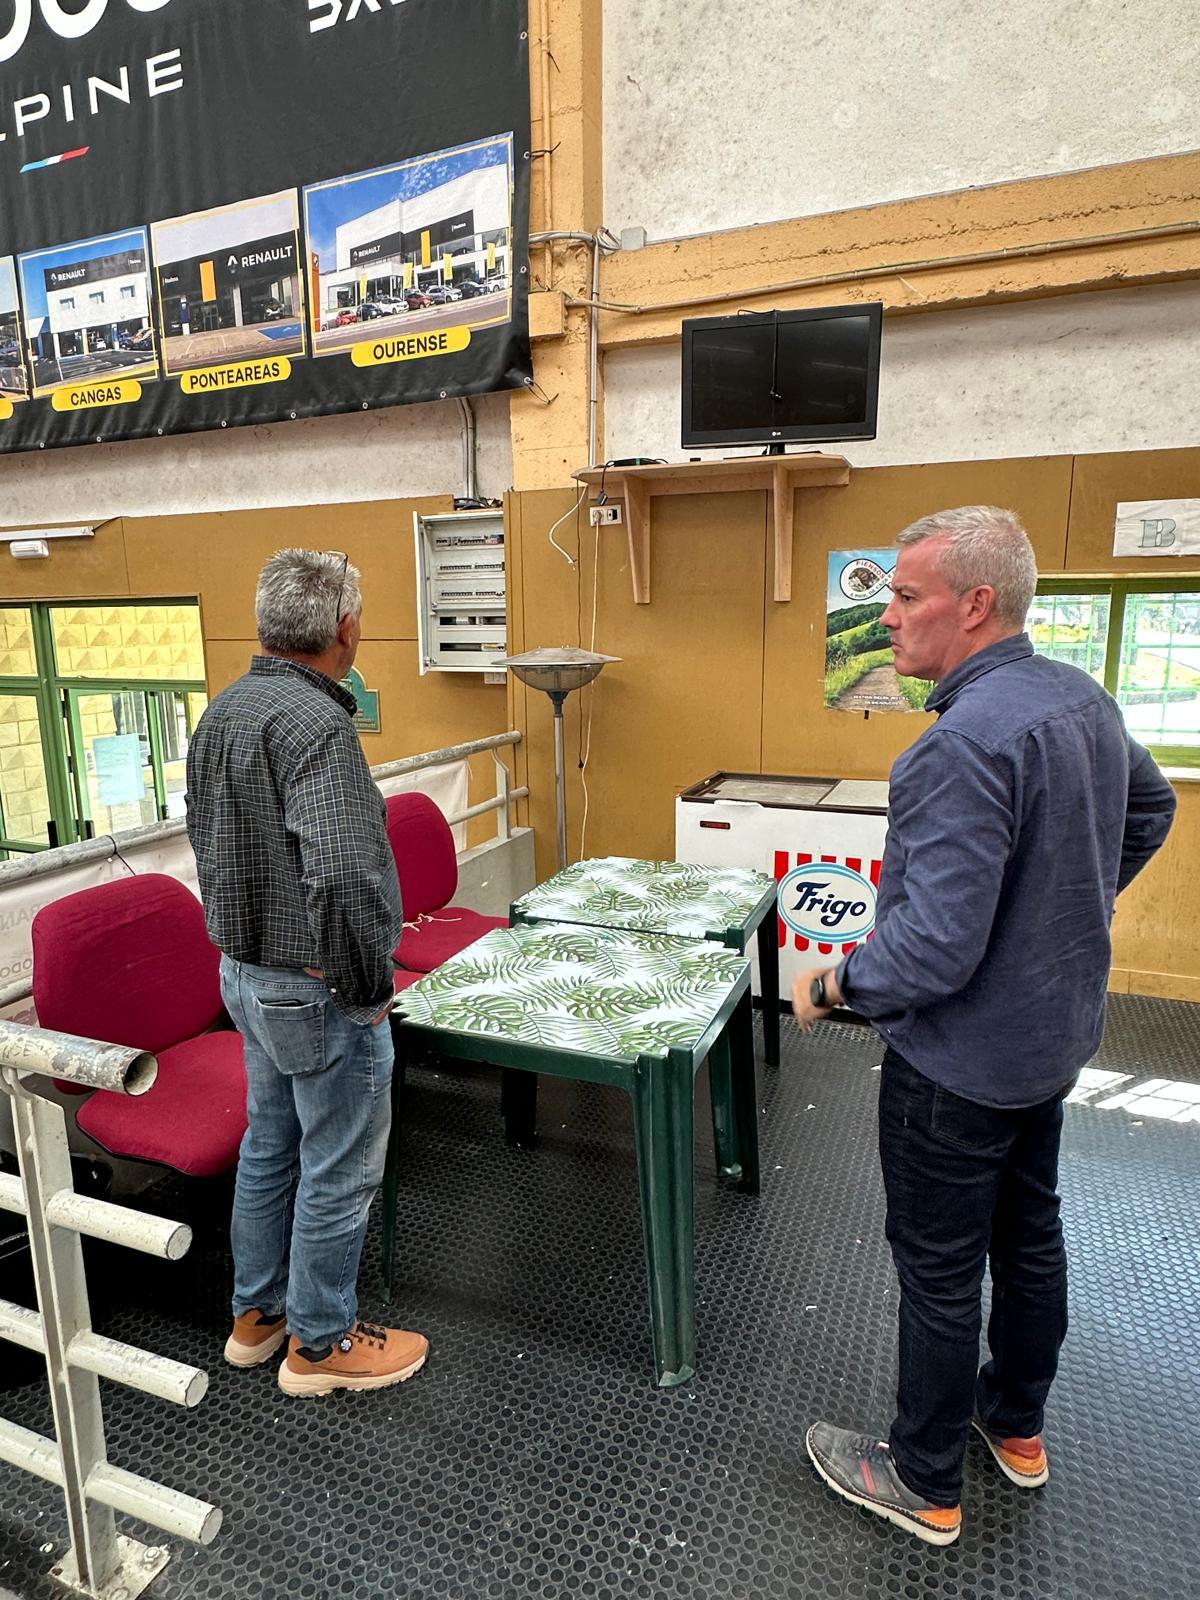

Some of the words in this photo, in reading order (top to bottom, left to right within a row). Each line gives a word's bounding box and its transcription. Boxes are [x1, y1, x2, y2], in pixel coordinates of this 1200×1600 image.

[0, 48, 184, 142] PINE
[241, 245, 293, 268] RENAULT
[57, 268, 86, 282] RENAULT
[373, 333, 448, 360] OURENSE
[189, 362, 280, 390] PONTEAREAS
[70, 386, 122, 406] CANGAS
[1137, 518, 1177, 549] B
[855, 560, 885, 580] PIENSOS
[791, 881, 867, 927] Frigo
